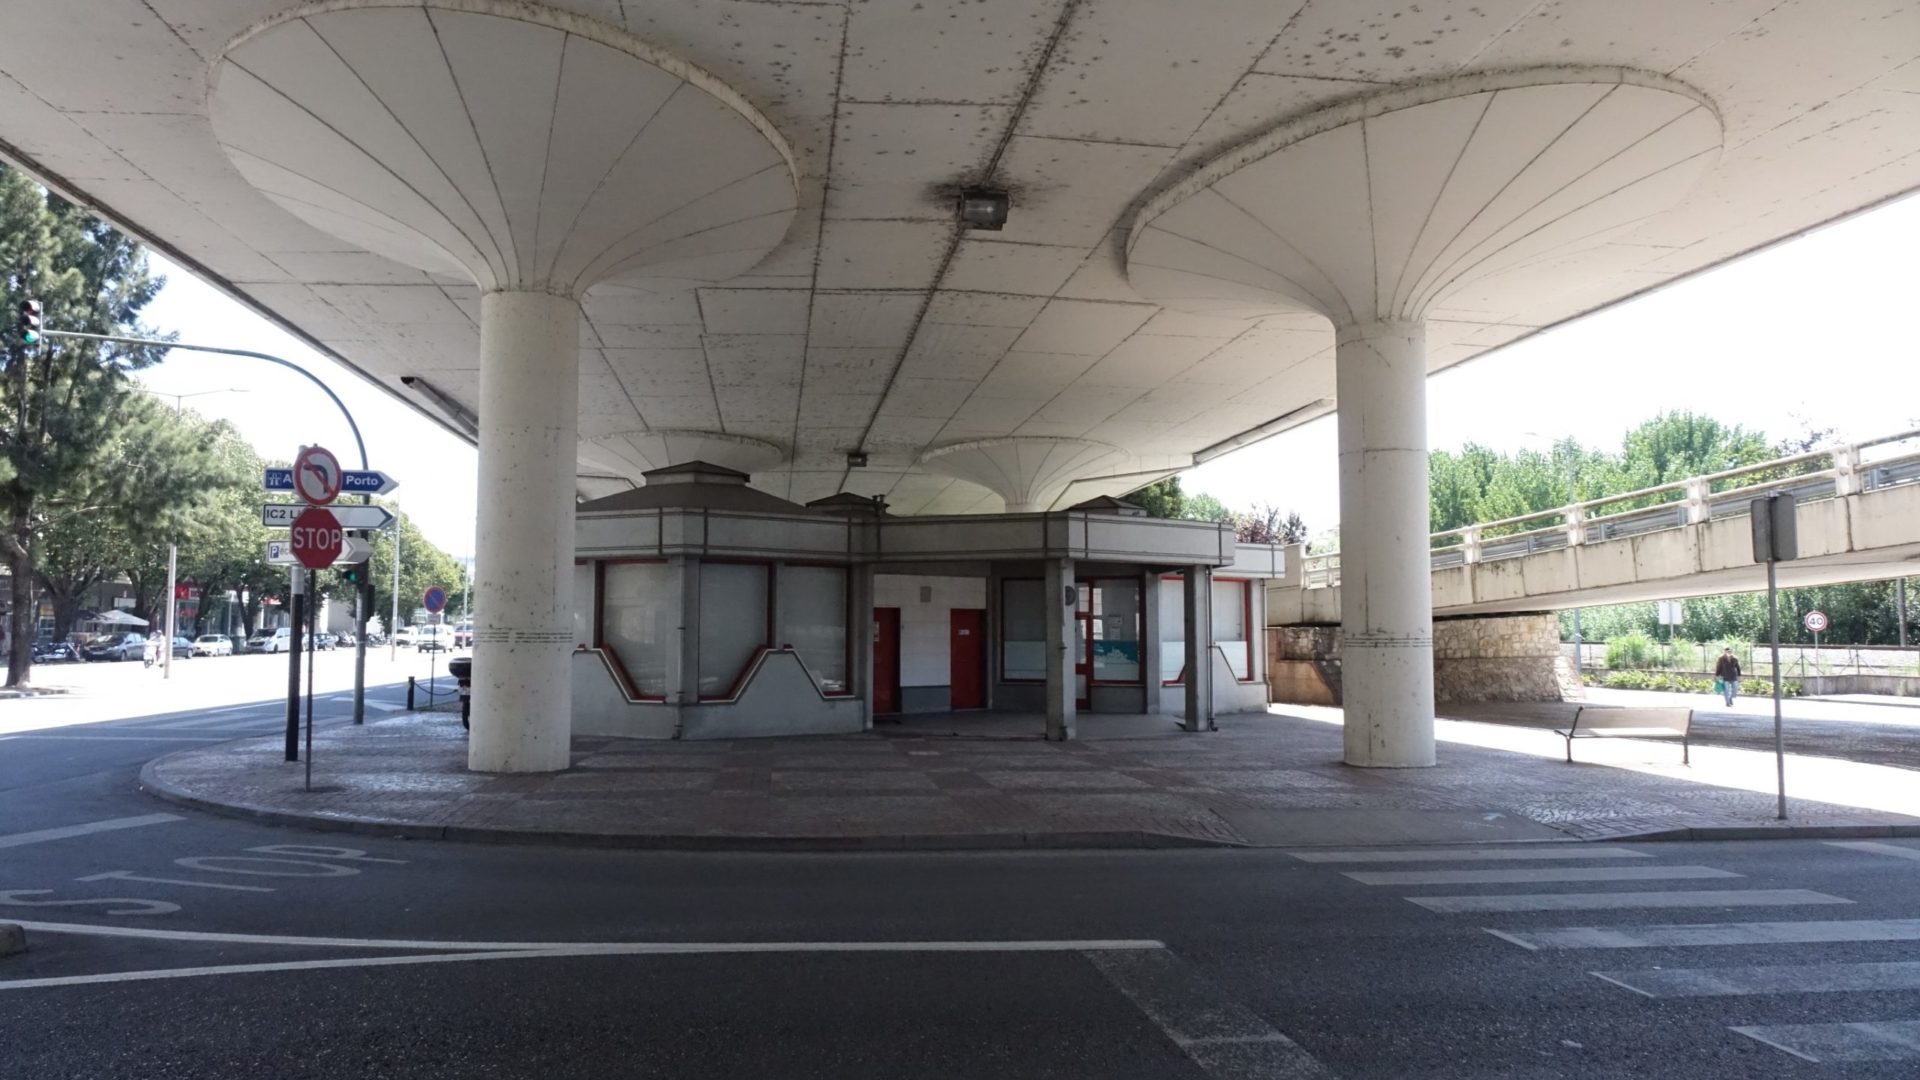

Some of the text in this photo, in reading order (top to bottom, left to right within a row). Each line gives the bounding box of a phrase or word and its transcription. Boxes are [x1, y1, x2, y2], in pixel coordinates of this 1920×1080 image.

[346, 475, 379, 486] Porto
[266, 509, 286, 519] IC2
[293, 526, 341, 550] STOP
[1810, 617, 1824, 625] 40
[0, 844, 409, 915] STOP
